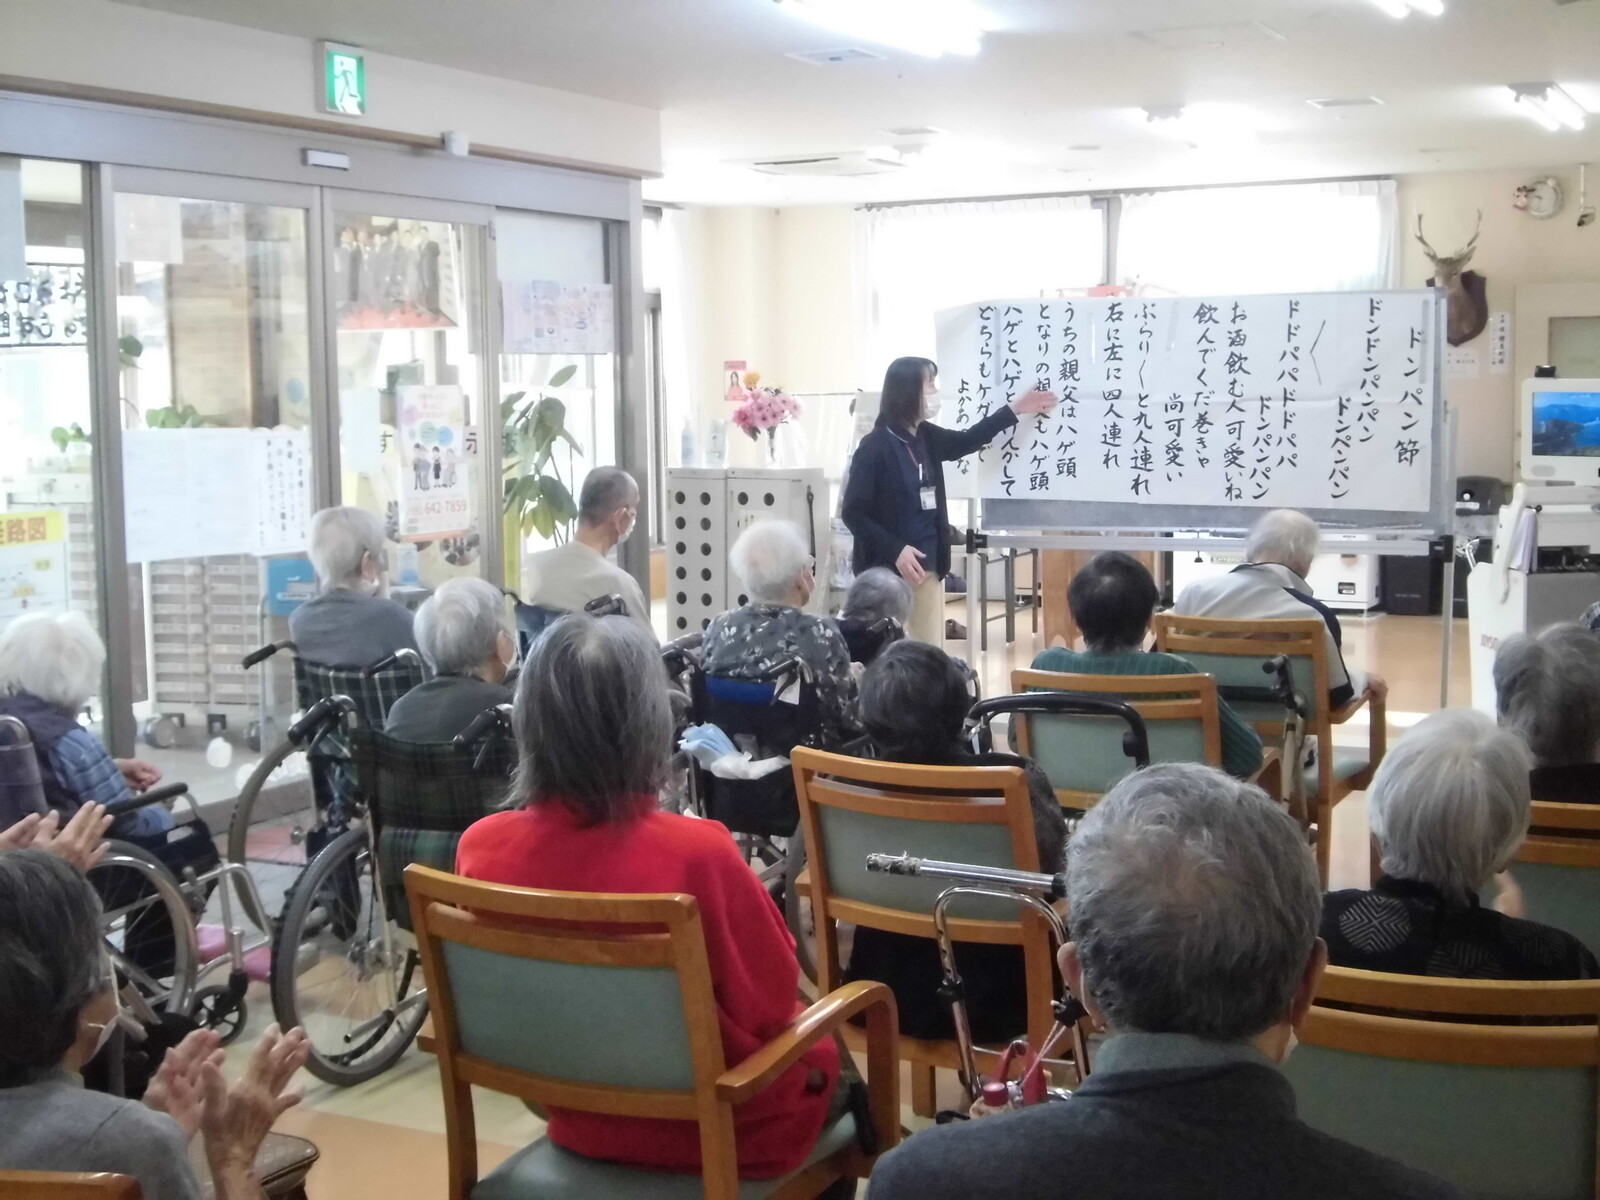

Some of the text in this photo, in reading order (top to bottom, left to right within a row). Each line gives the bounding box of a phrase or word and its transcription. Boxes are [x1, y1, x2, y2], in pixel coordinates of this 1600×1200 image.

[1056, 302, 1080, 478] うちの親父はハゲ頭
[1101, 302, 1124, 469] 右に左に四人連れ
[1164, 393, 1185, 482] 尚可愛い
[1223, 301, 1251, 501] お酒飲む人可愛いね
[1276, 299, 1300, 468] ドドパパドドパパ
[1357, 297, 1383, 443] ドンドンパンパン
[1394, 326, 1423, 467] ドンパン節
[1249, 395, 1273, 500] ドンパンパン
[1328, 395, 1352, 499] ドンペンパン
[0, 517, 47, 543] 路図
